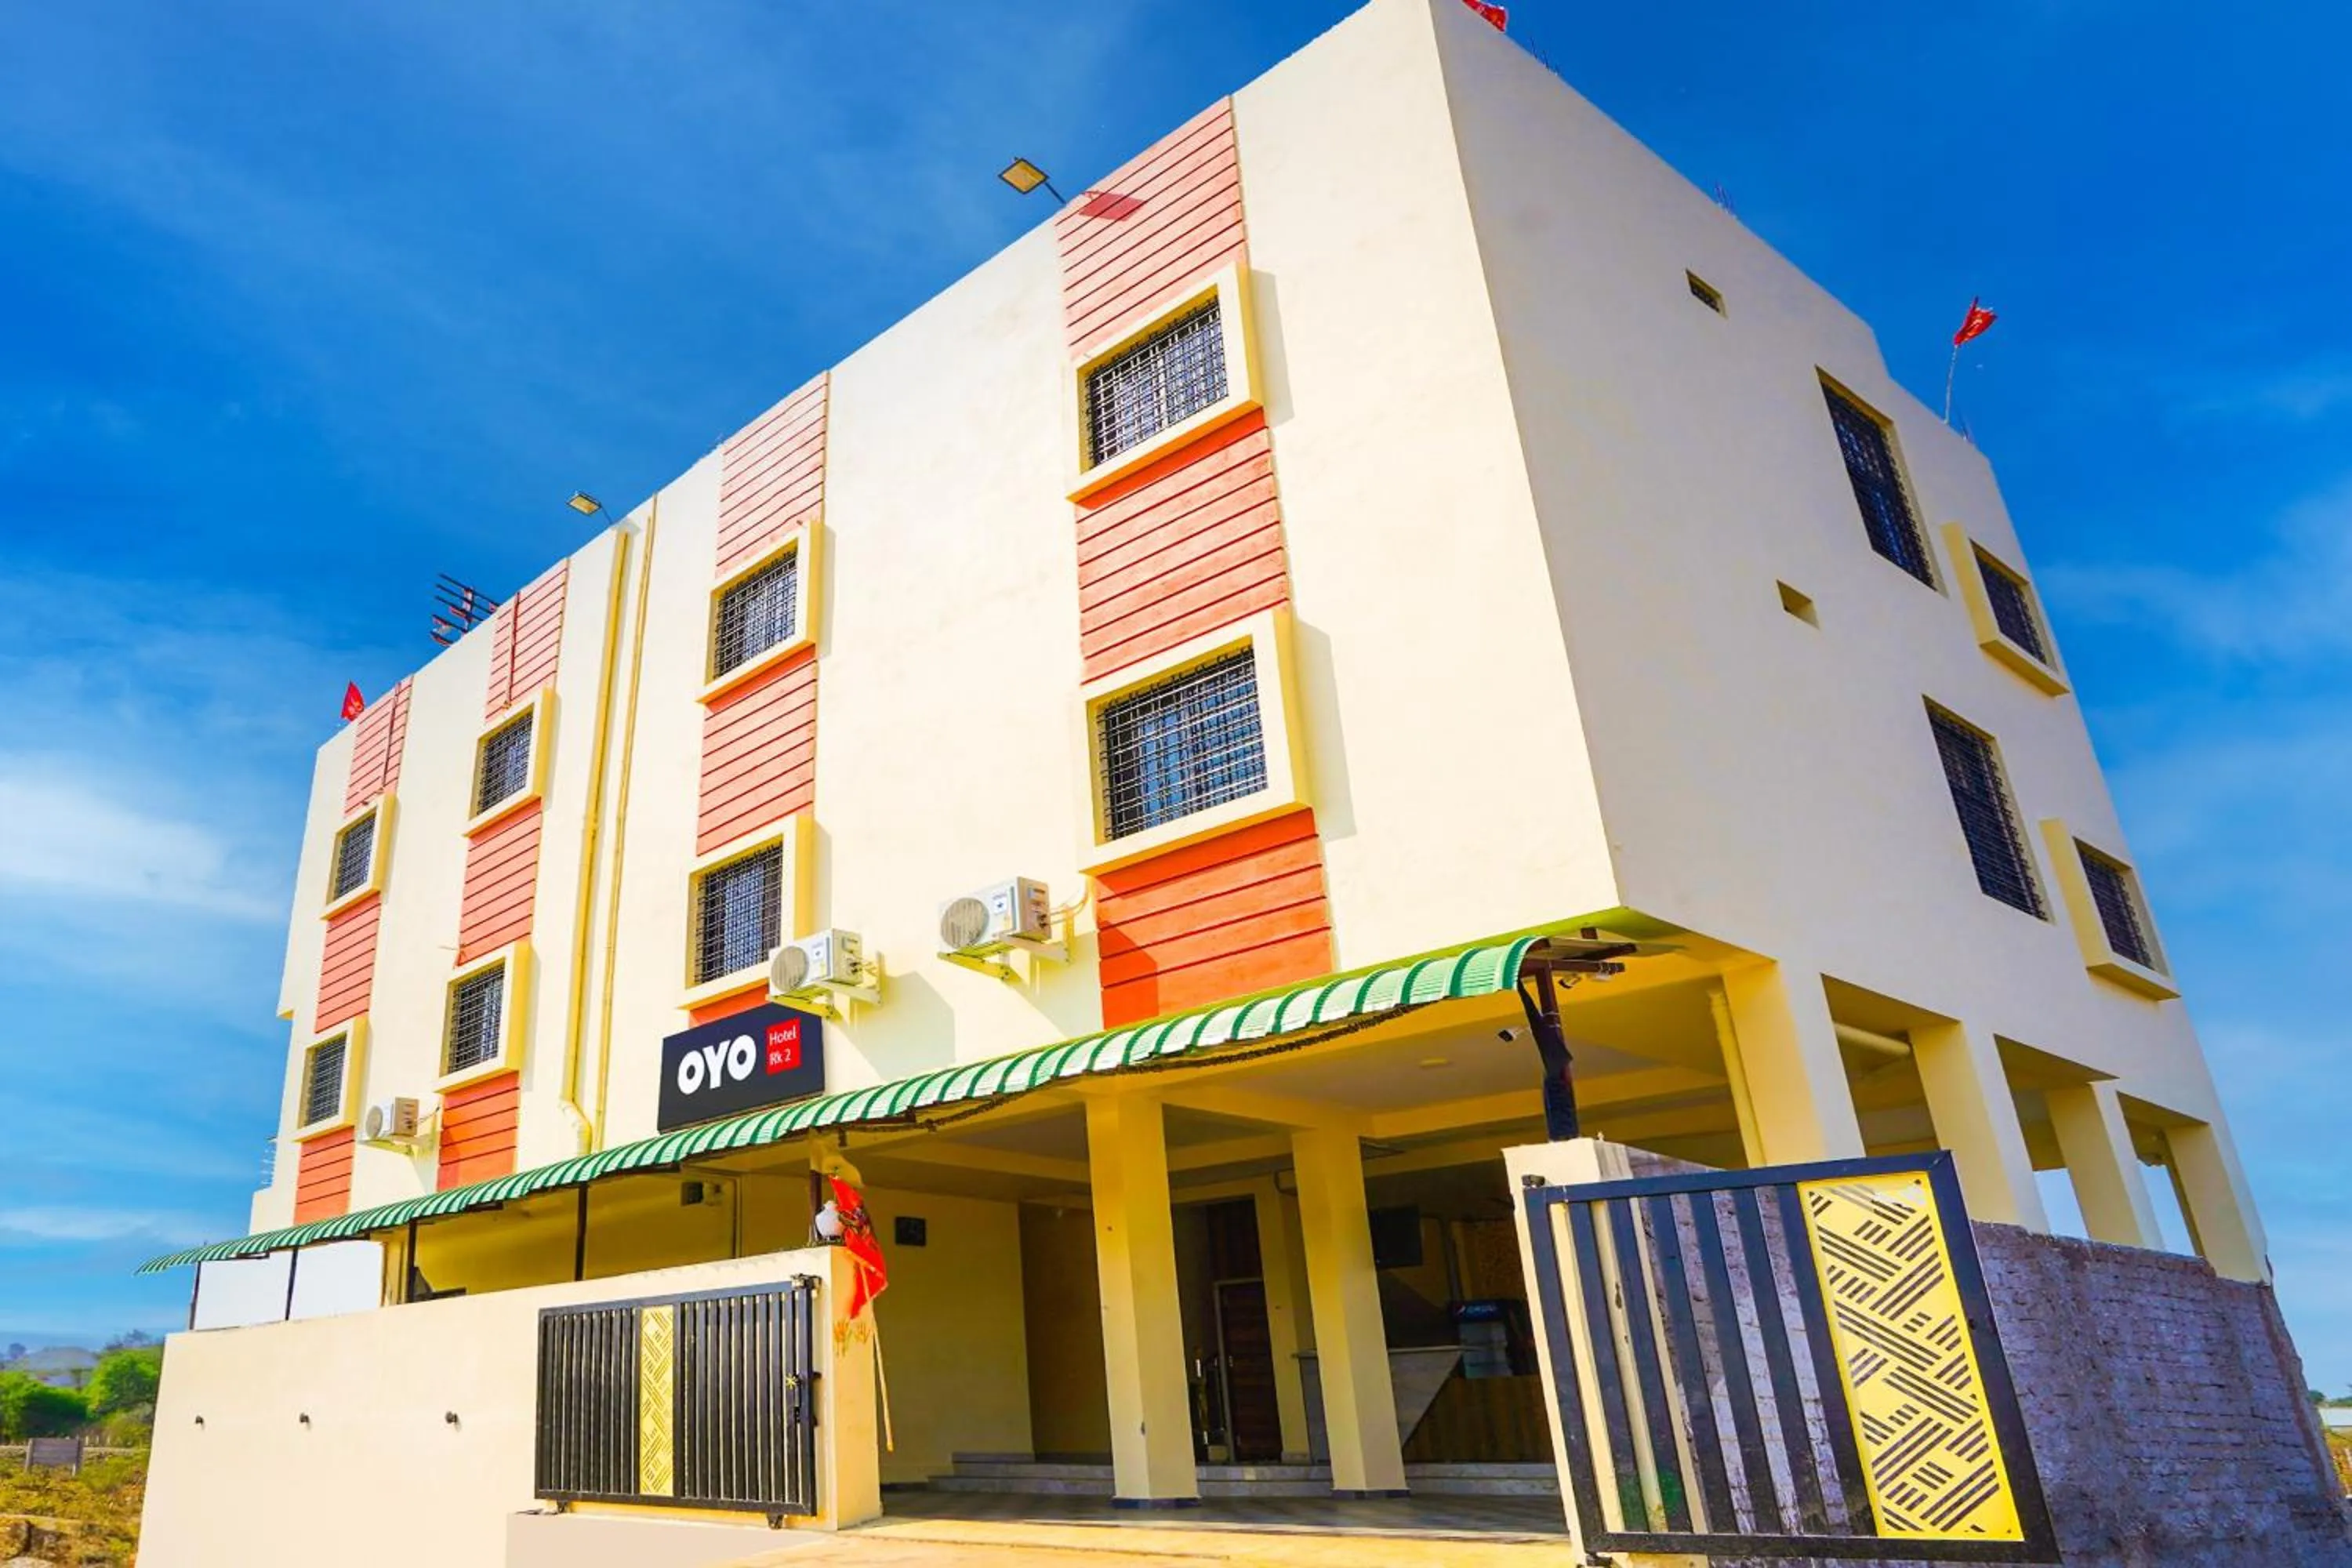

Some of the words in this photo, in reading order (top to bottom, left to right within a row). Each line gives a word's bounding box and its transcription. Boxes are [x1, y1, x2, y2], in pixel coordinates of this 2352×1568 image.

[769, 1025, 797, 1047] Hotel
[677, 1034, 757, 1095] OYO
[784, 1048, 791, 1062] 2
